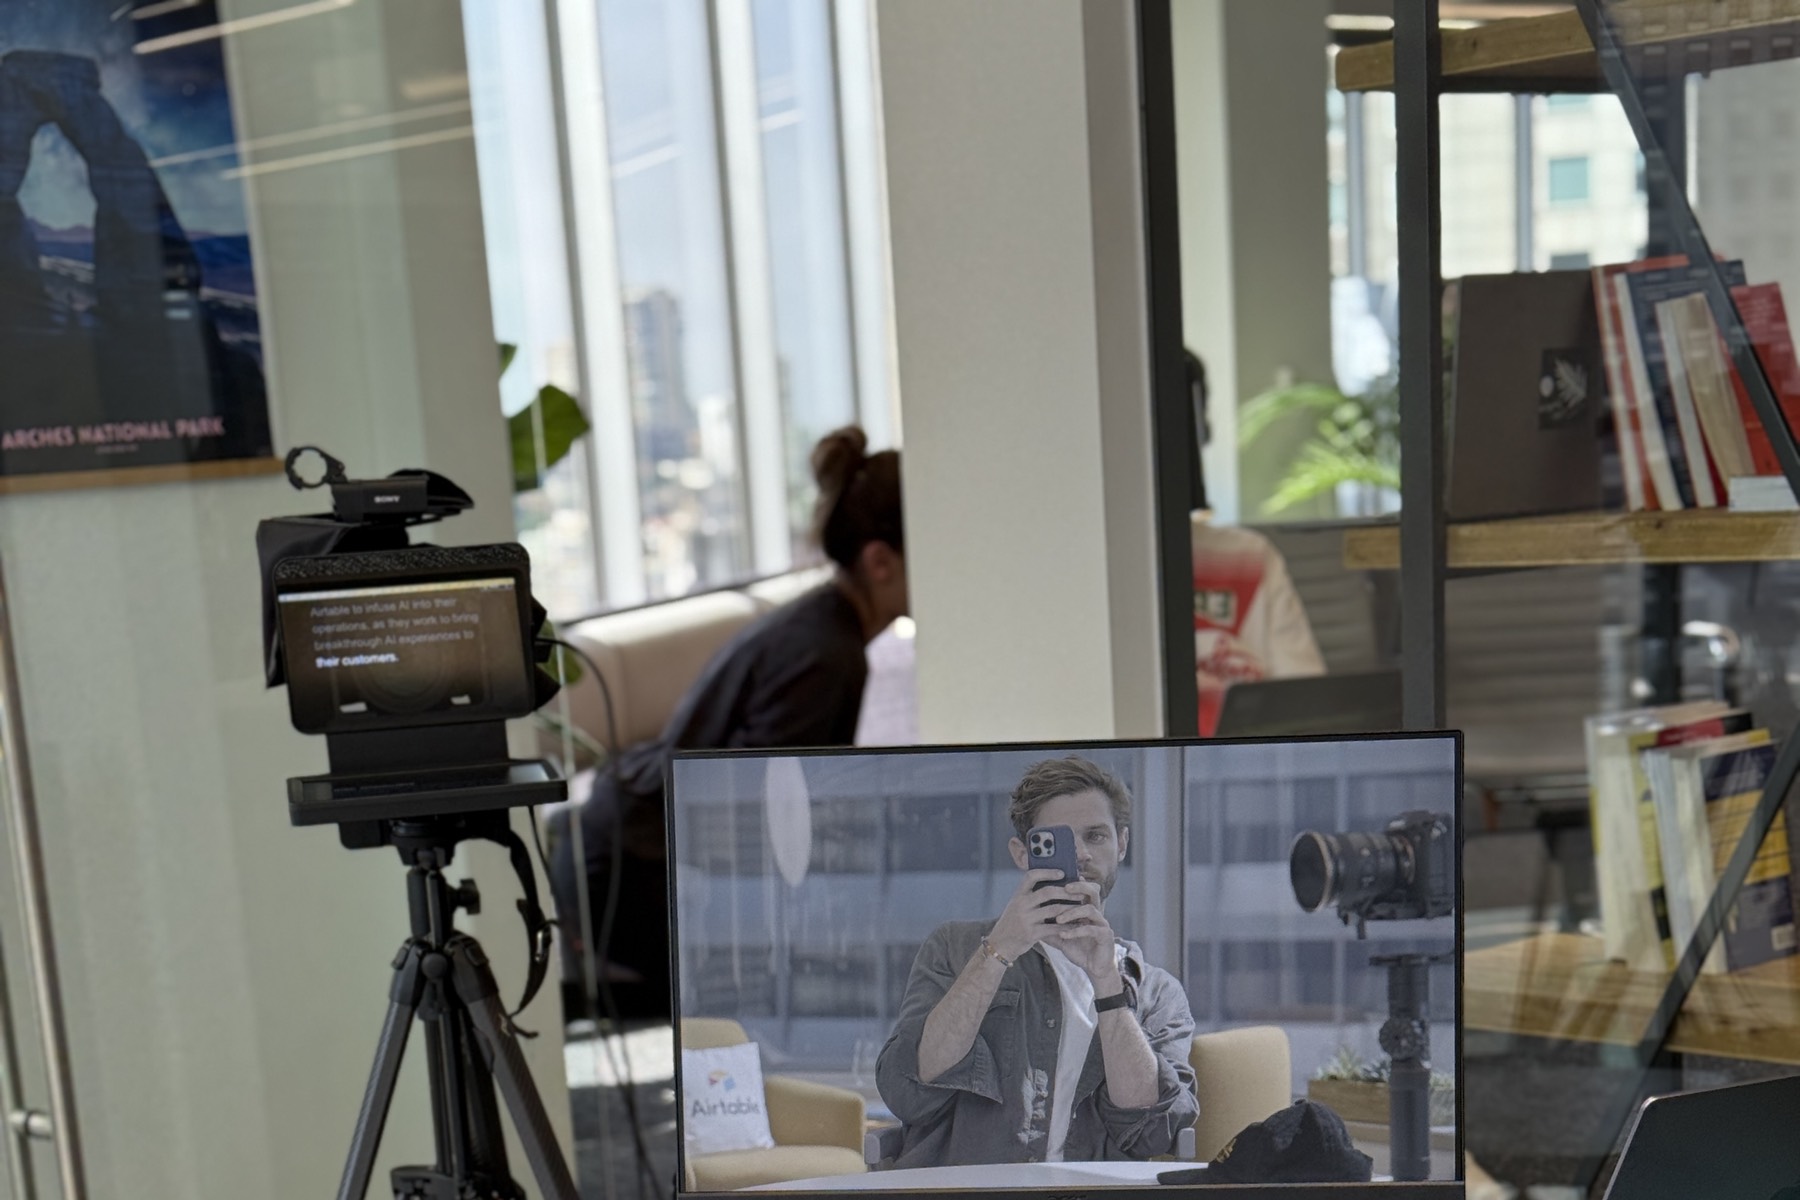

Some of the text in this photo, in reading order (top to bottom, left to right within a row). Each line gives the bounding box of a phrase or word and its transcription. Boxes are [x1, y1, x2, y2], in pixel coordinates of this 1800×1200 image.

[1, 425, 75, 449] ARCHES
[77, 420, 171, 445] NATIONAL
[175, 416, 225, 438] PARK
[374, 495, 400, 504] SONY
[310, 597, 457, 617] Airtable to infuse AI into their
[372, 620, 385, 630] as
[387, 618, 414, 630] they
[414, 615, 437, 626] work
[440, 614, 450, 624] to
[452, 611, 479, 624] bring
[313, 637, 383, 651] breakthrough
[398, 631, 461, 646] experiences
[463, 629, 474, 640] to
[315, 653, 399, 668] their customers.
